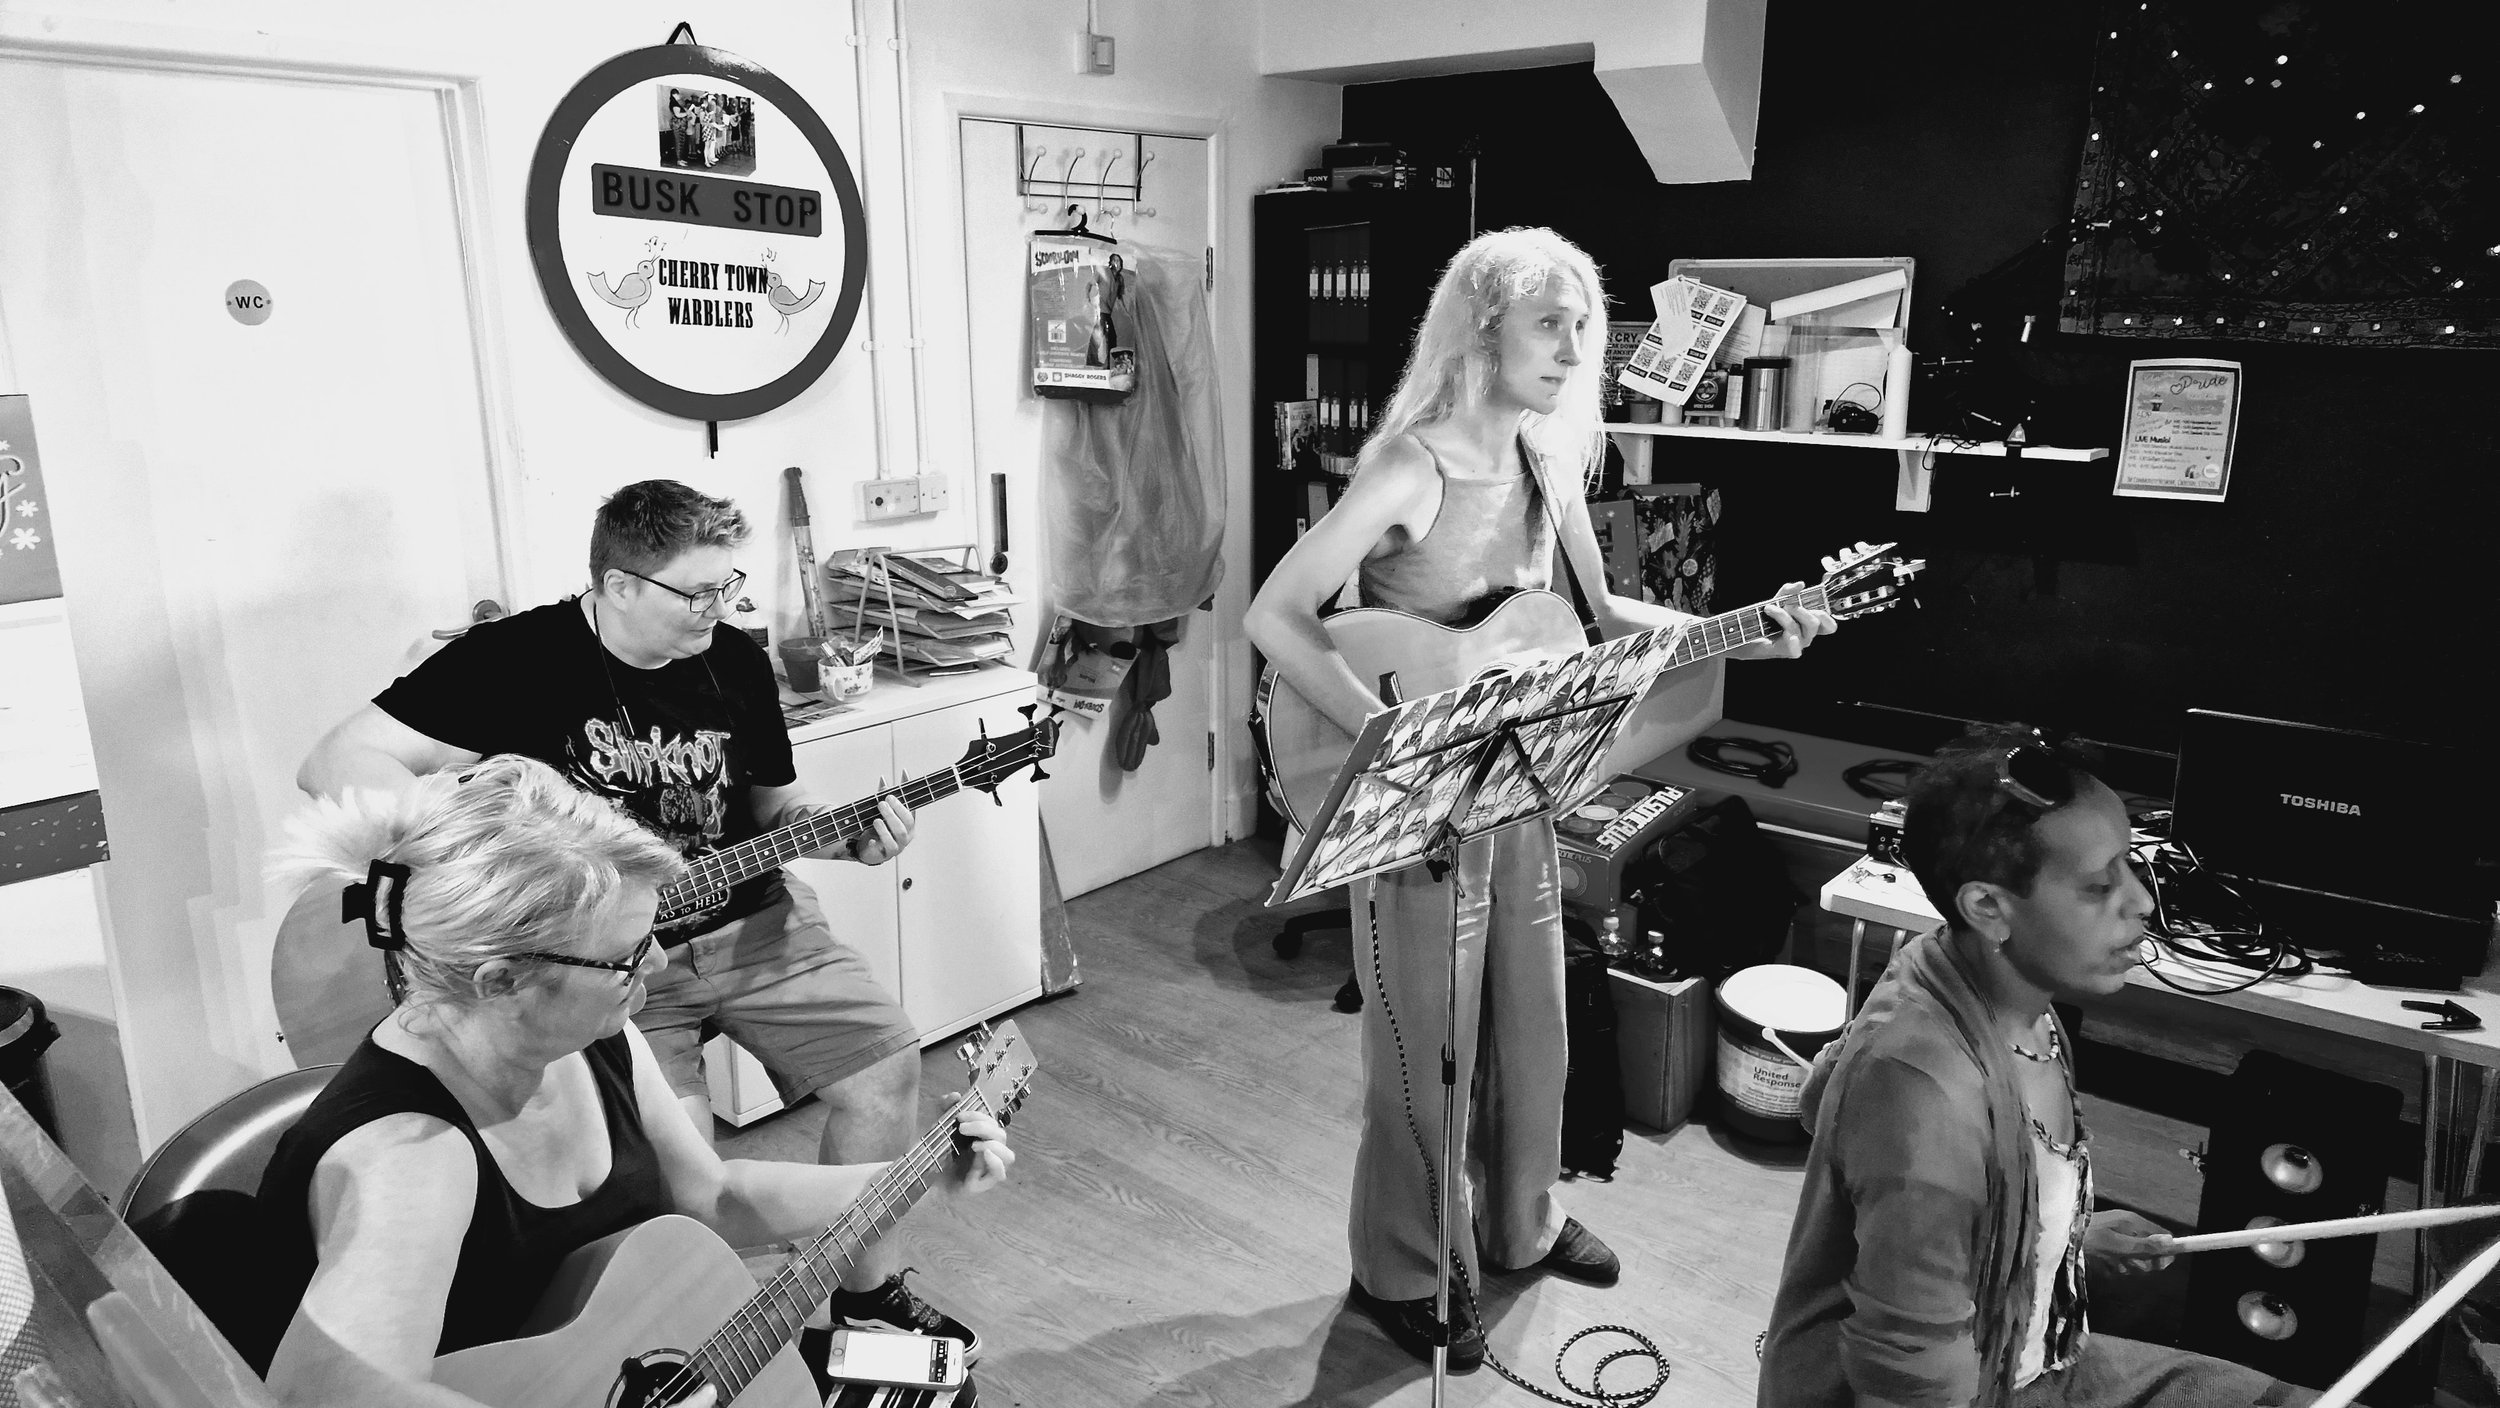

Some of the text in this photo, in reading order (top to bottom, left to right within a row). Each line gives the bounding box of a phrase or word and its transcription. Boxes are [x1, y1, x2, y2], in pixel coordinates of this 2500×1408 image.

[602, 171, 817, 228] BUSK STOP
[658, 258, 768, 294] CHERRY TOWN
[235, 296, 264, 308] WC
[667, 297, 754, 328] WARBLERS
[1614, 333, 1641, 343] CRY.
[2280, 793, 2361, 816] TOSHIBA
[695, 892, 724, 910] HELL
[1753, 1073, 1801, 1088] Response
[1754, 1066, 1789, 1081] United
